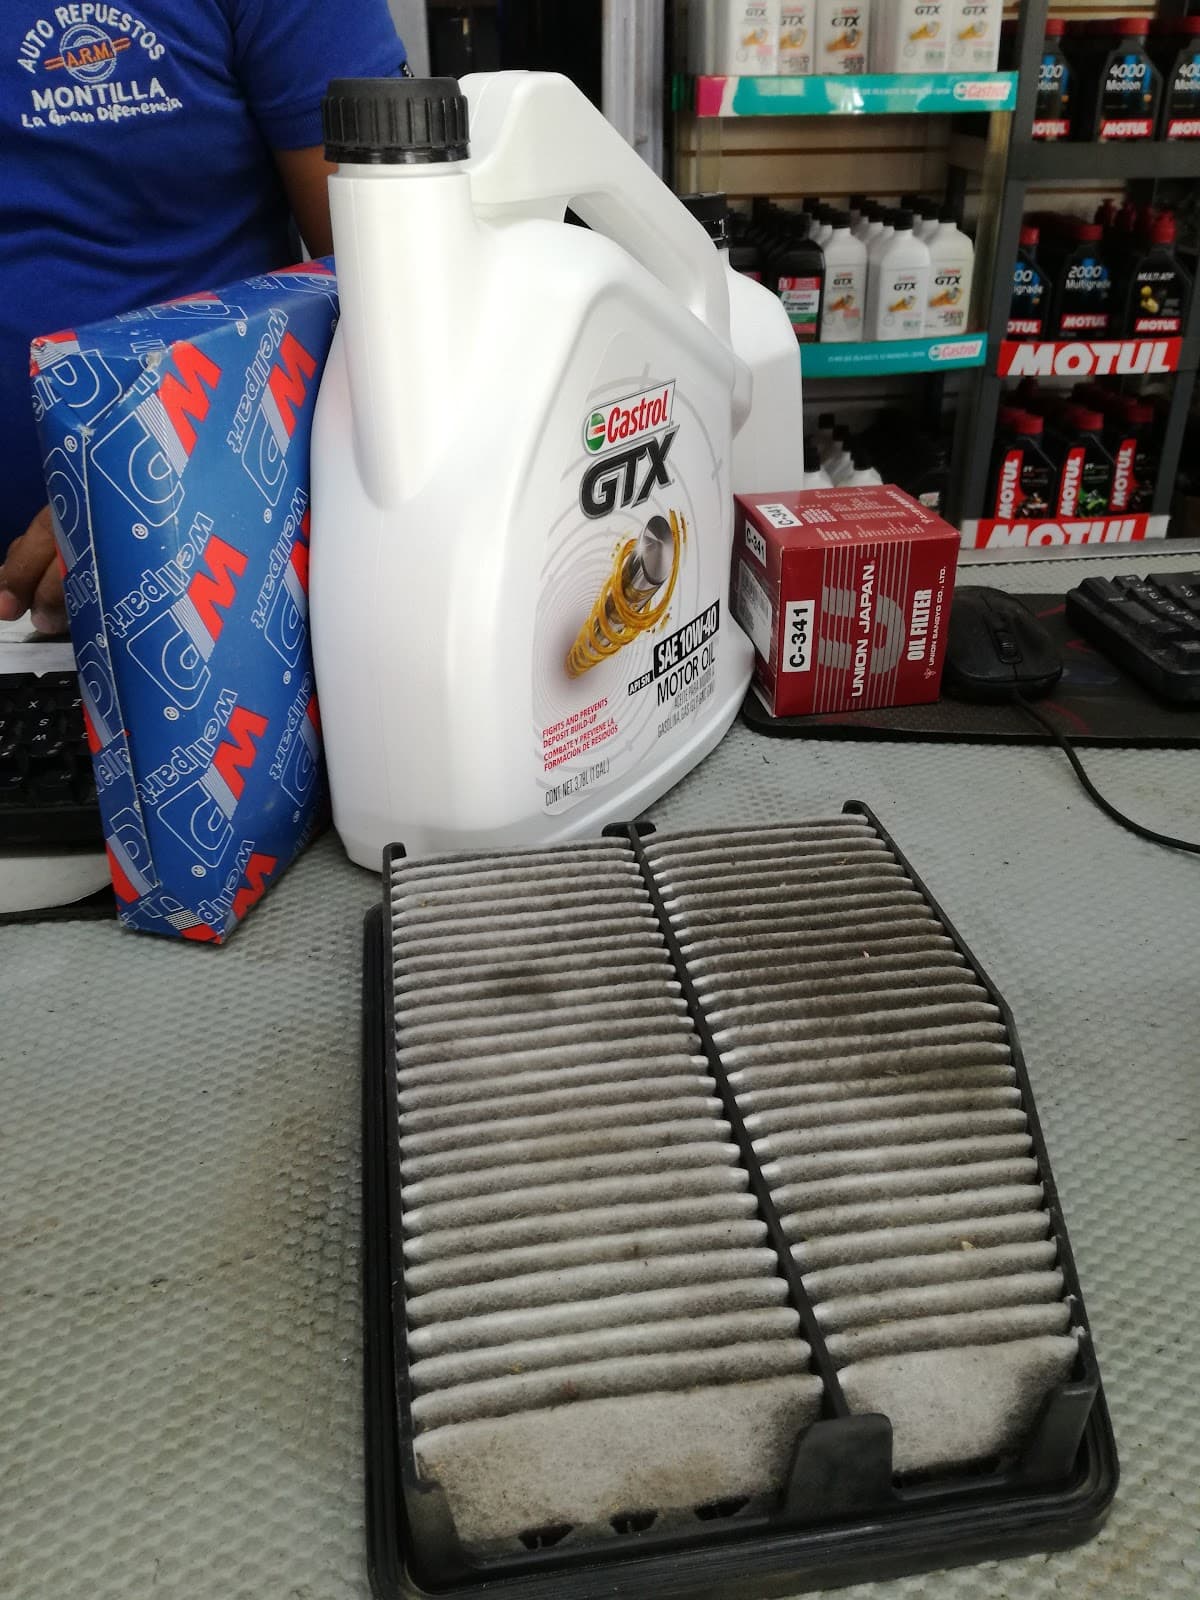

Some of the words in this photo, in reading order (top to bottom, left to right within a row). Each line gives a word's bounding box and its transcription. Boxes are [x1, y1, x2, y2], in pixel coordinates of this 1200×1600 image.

[831, 16, 859, 27] GTX
[914, 6, 941, 15] GTX
[962, 6, 988, 15] GTX
[17, 19, 54, 73] AUTO
[55, 3, 165, 60] REPUESTOS
[1106, 80, 1141, 91] Motion
[1110, 64, 1145, 78] 4000
[31, 78, 166, 111] MONTILLA
[21, 113, 46, 128] La
[49, 108, 95, 126] Gran
[97, 96, 183, 123] Diferencia
[1103, 122, 1148, 135] MOTUL
[1170, 122, 1200, 135] MOT
[893, 282, 916, 291] GTX
[934, 275, 961, 286] GTX
[1068, 266, 1102, 278] 2000
[1008, 321, 1037, 333] OTUL
[1063, 316, 1105, 328] MOTUL
[1137, 320, 1177, 331] MOTUL
[1008, 342, 1170, 376] MOTUL
[226, 308, 288, 453] Wellpart
[607, 389, 668, 443] Castrol
[579, 425, 680, 519] GTX
[998, 459, 1019, 519] MOTUL
[1060, 457, 1080, 517] MOTUL
[1111, 448, 1132, 507] MOTUL
[104, 512, 214, 638] Wellpart
[859, 565, 875, 633] JAPAN
[910, 589, 932, 636] FILTER
[658, 634, 678, 673] SAE
[680, 605, 717, 657] 10W-40
[789, 608, 808, 667] C-341
[907, 638, 926, 661] OIL
[657, 655, 698, 706] MOTOR
[702, 641, 716, 671] OIL
[852, 638, 868, 697] UNION
[542, 721, 565, 738] FIGHTS
[566, 714, 579, 727] AND
[580, 698, 608, 716] PREVENTS
[543, 729, 569, 748] DEPOSIT
[571, 714, 597, 734] BUILD-UP
[136, 689, 238, 805] Wellpart
[544, 741, 574, 761] COMBATE
[580, 722, 606, 742] PREVIENE
[582, 742, 590, 752] DE
[592, 724, 618, 746] RESIDUOS
[198, 840, 255, 925] Wellp
